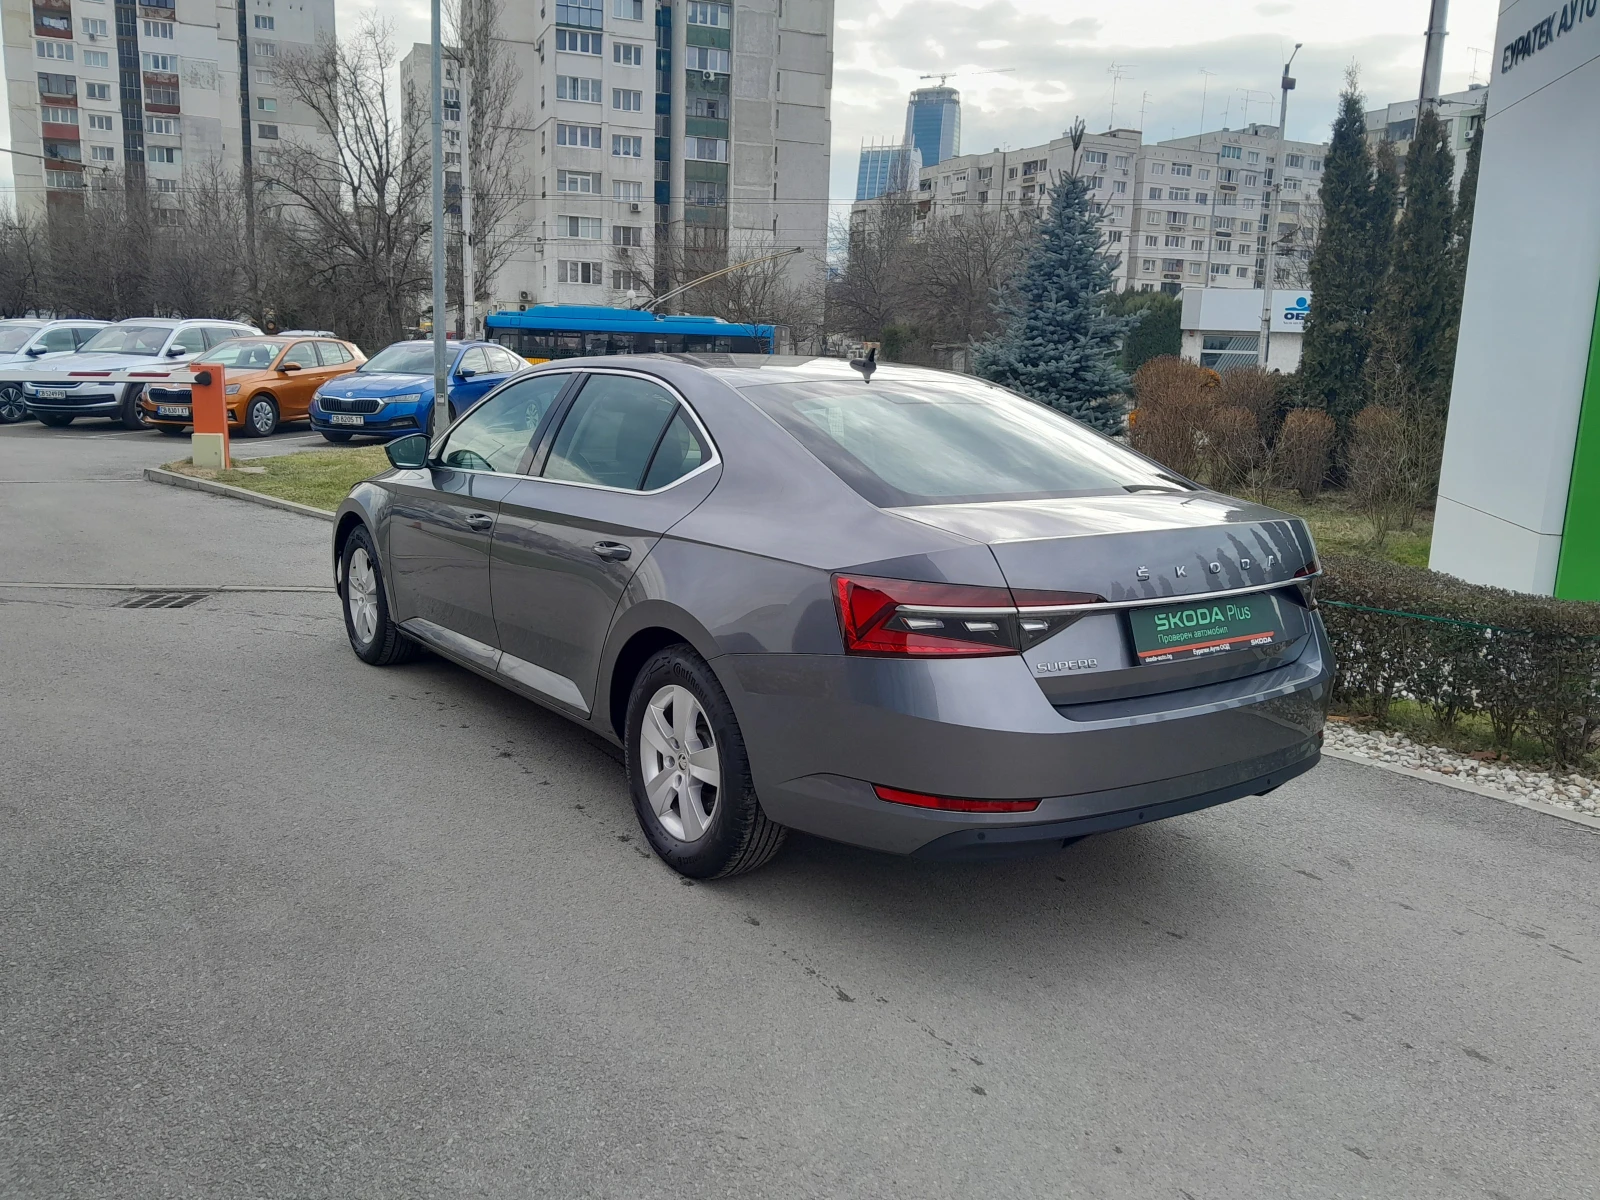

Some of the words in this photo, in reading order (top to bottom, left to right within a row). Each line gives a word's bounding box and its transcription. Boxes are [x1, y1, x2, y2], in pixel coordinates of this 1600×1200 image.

[1501, 11, 1557, 74] ЕУРАТЕК
[1284, 312, 1306, 320] ОБ
[1137, 555, 1275, 581] ŠKODA
[1226, 604, 1251, 620] Plus
[1157, 632, 1193, 644] Проверен
[1193, 626, 1229, 638] автомобил
[1036, 658, 1098, 673] SUPERB
[673, 662, 714, 709] Continental
